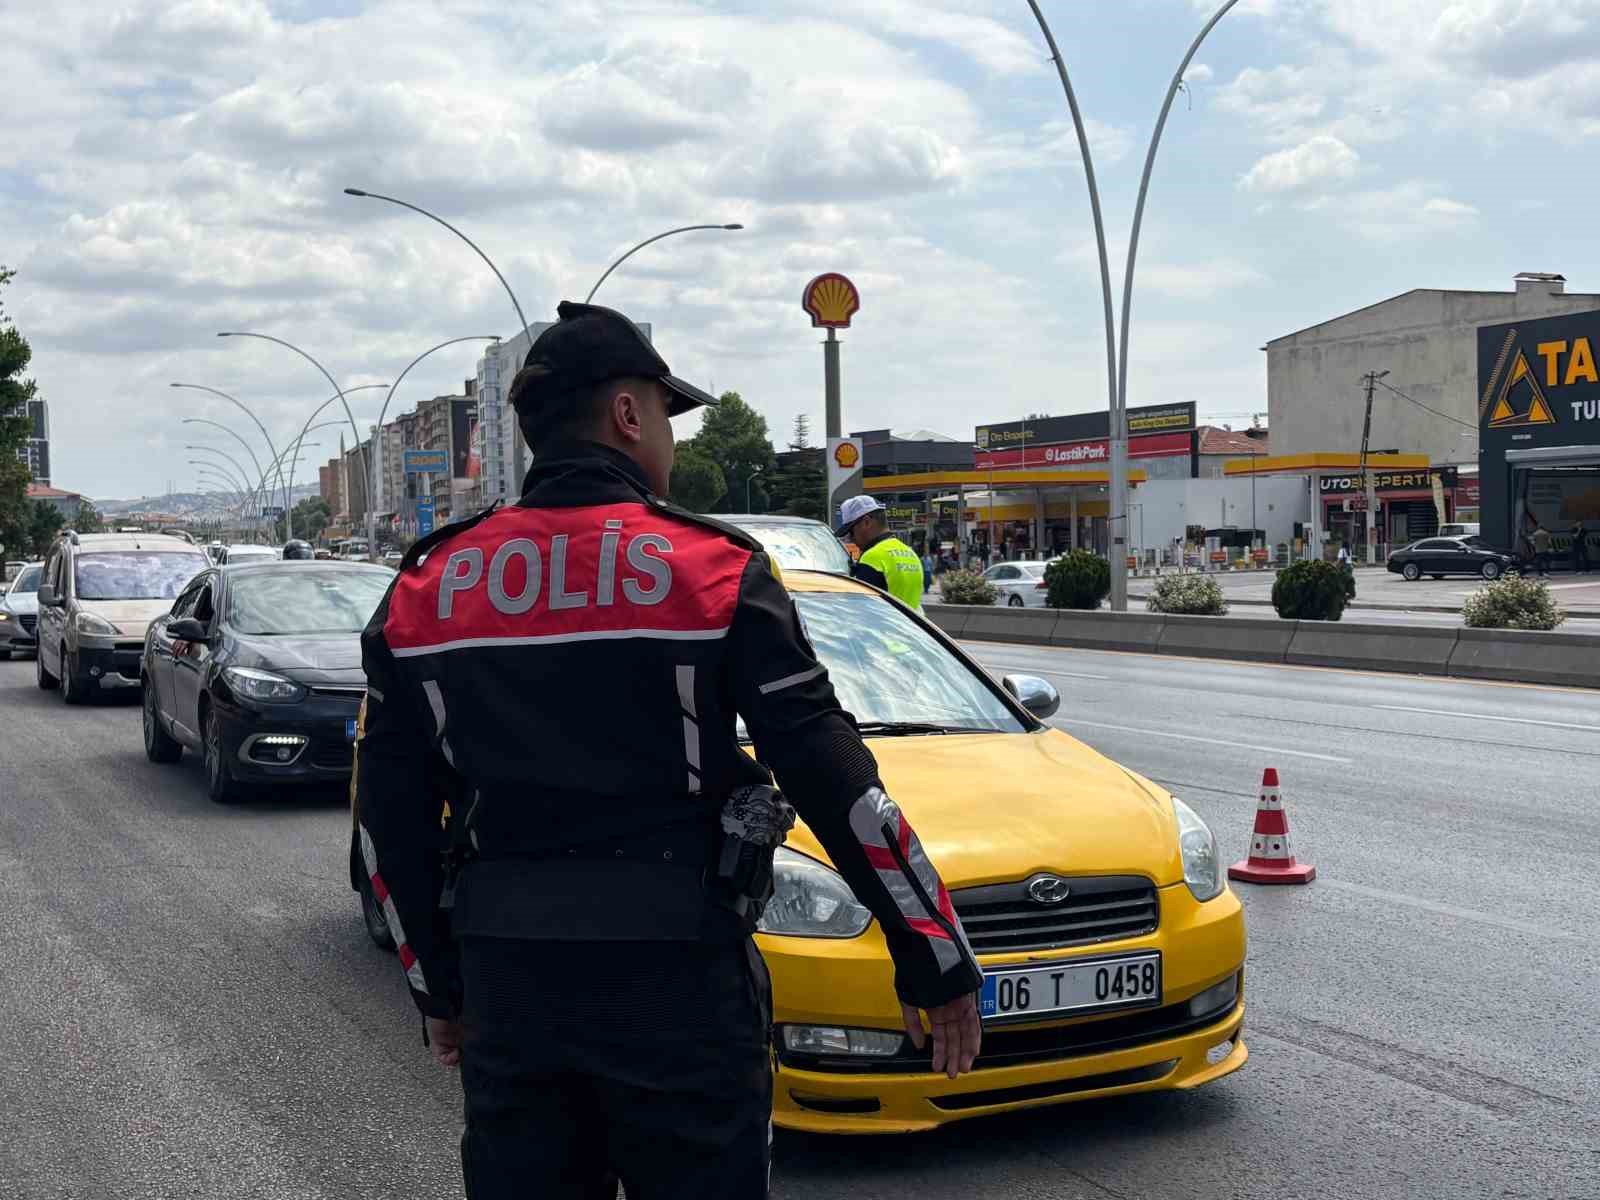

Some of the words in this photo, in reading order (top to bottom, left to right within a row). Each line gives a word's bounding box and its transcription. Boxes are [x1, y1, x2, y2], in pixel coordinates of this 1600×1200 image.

[1571, 400, 1600, 421] TU
[1055, 446, 1105, 462] LastikPark
[438, 519, 673, 620] POLİS
[983, 1000, 994, 1009] TR
[999, 976, 1031, 1011] 06
[1051, 973, 1065, 1006] T
[1095, 963, 1155, 1001] 0458
